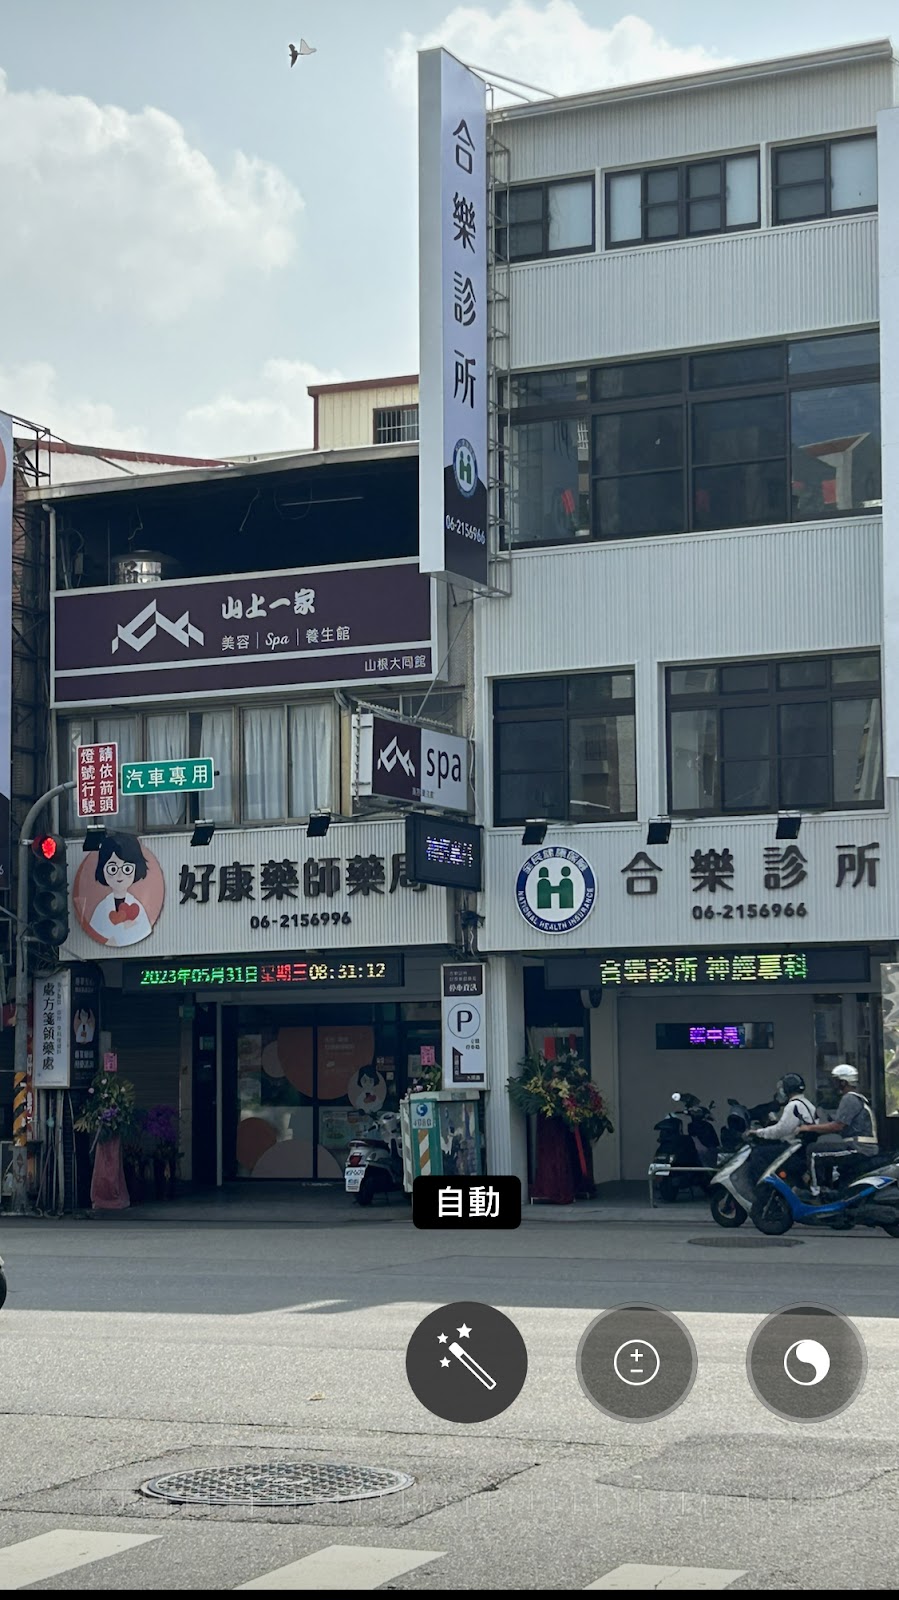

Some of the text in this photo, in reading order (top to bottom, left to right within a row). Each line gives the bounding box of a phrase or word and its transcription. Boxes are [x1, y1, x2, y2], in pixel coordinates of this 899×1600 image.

[453, 118, 476, 409] 合樂診所
[445, 514, 486, 545] 06-2156966
[221, 588, 315, 620] 山上一家
[221, 626, 350, 651] 美容 Spa 養生館
[364, 655, 426, 672] 山根大同館
[80, 748, 96, 814] 燈號行駛
[99, 746, 114, 812] 請依箭頭
[126, 765, 207, 789] 汽車專用
[426, 748, 462, 788] spa
[621, 842, 880, 896] 合樂診所
[250, 911, 352, 929] 06-2156996
[518, 887, 594, 931] NATIONAL HEALTH INSURANCE
[692, 903, 807, 919] 06-2156966
[309, 963, 386, 980] 08:31:12
[457, 1010, 473, 1032] P
